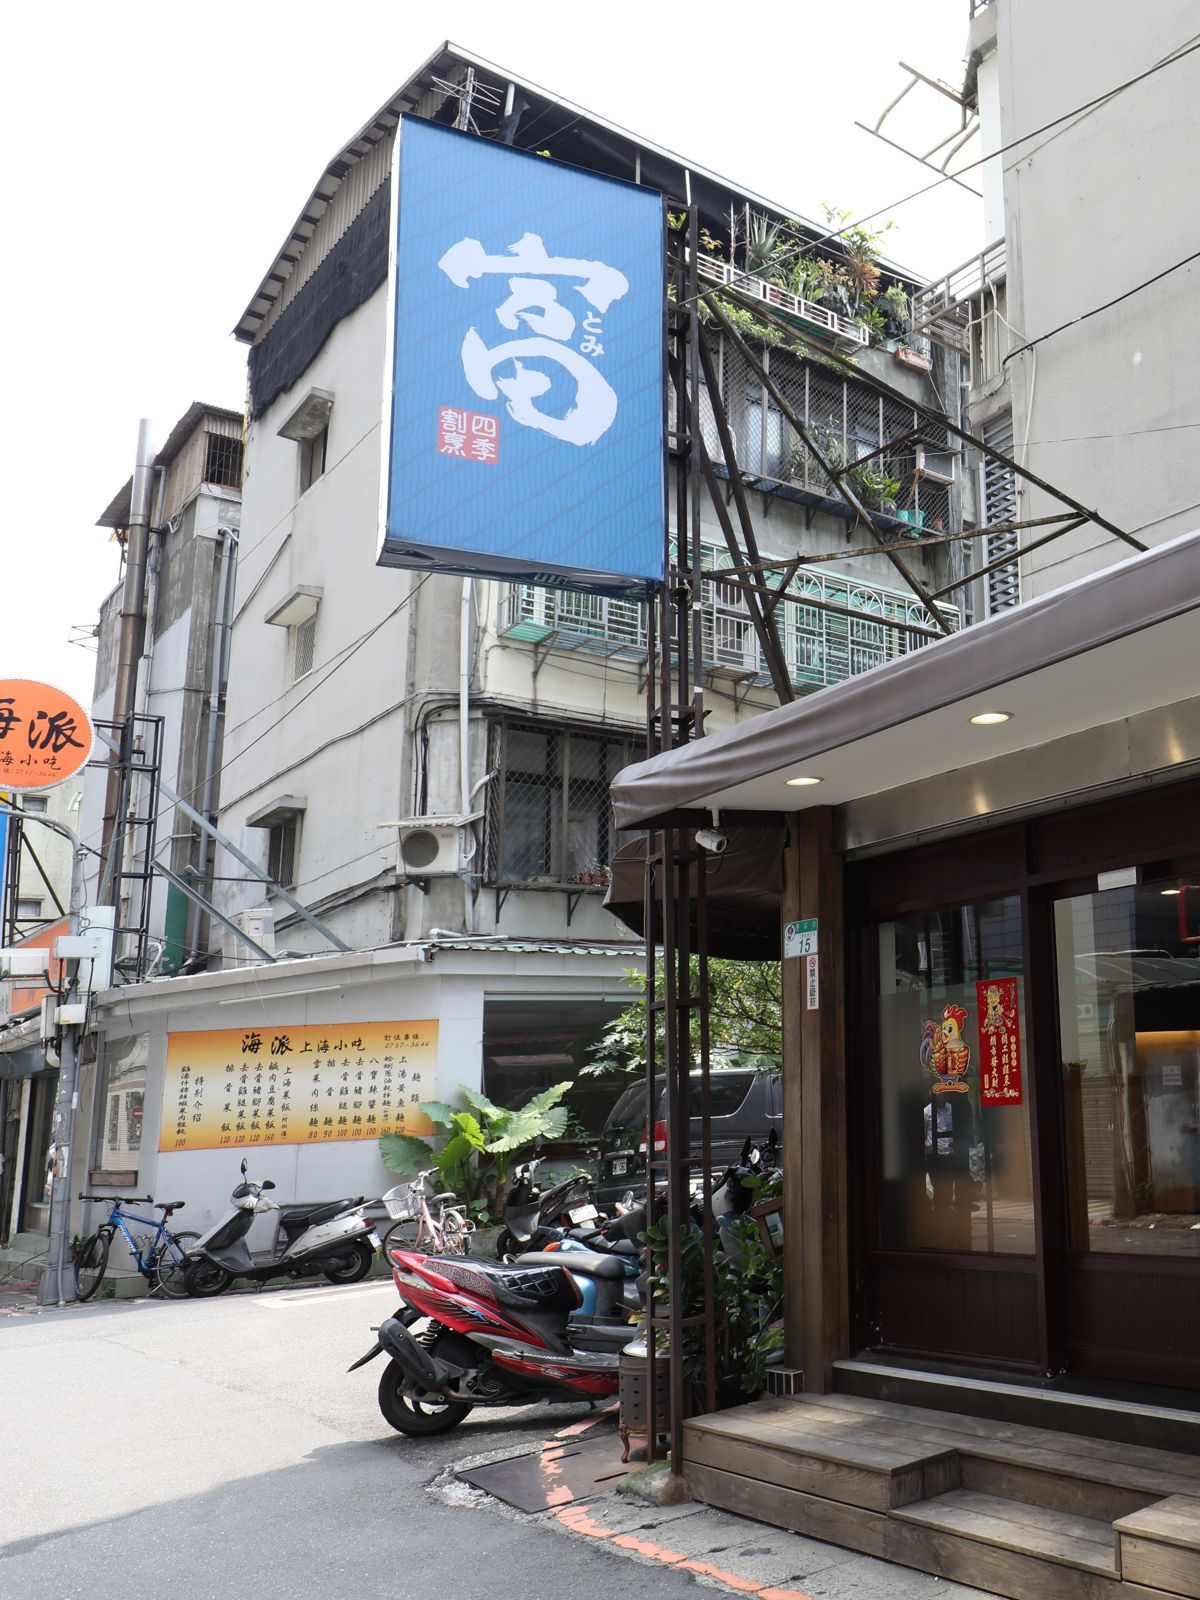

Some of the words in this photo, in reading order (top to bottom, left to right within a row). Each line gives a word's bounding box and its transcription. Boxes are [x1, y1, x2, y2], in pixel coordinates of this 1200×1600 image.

[437, 232, 630, 447] 富
[578, 311, 606, 357] とみ
[440, 408, 467, 458] 割烹
[470, 412, 499, 462] 四季
[799, 938, 811, 954] 15
[242, 1031, 293, 1056] 海派
[300, 1037, 366, 1054] 上海小吃
[384, 1040, 430, 1049] 2717-3646
[308, 1130, 318, 1139] 80
[323, 1130, 333, 1138] 90
[337, 1129, 348, 1137] 100
[352, 1128, 362, 1136] 100
[366, 1127, 377, 1136] 100
